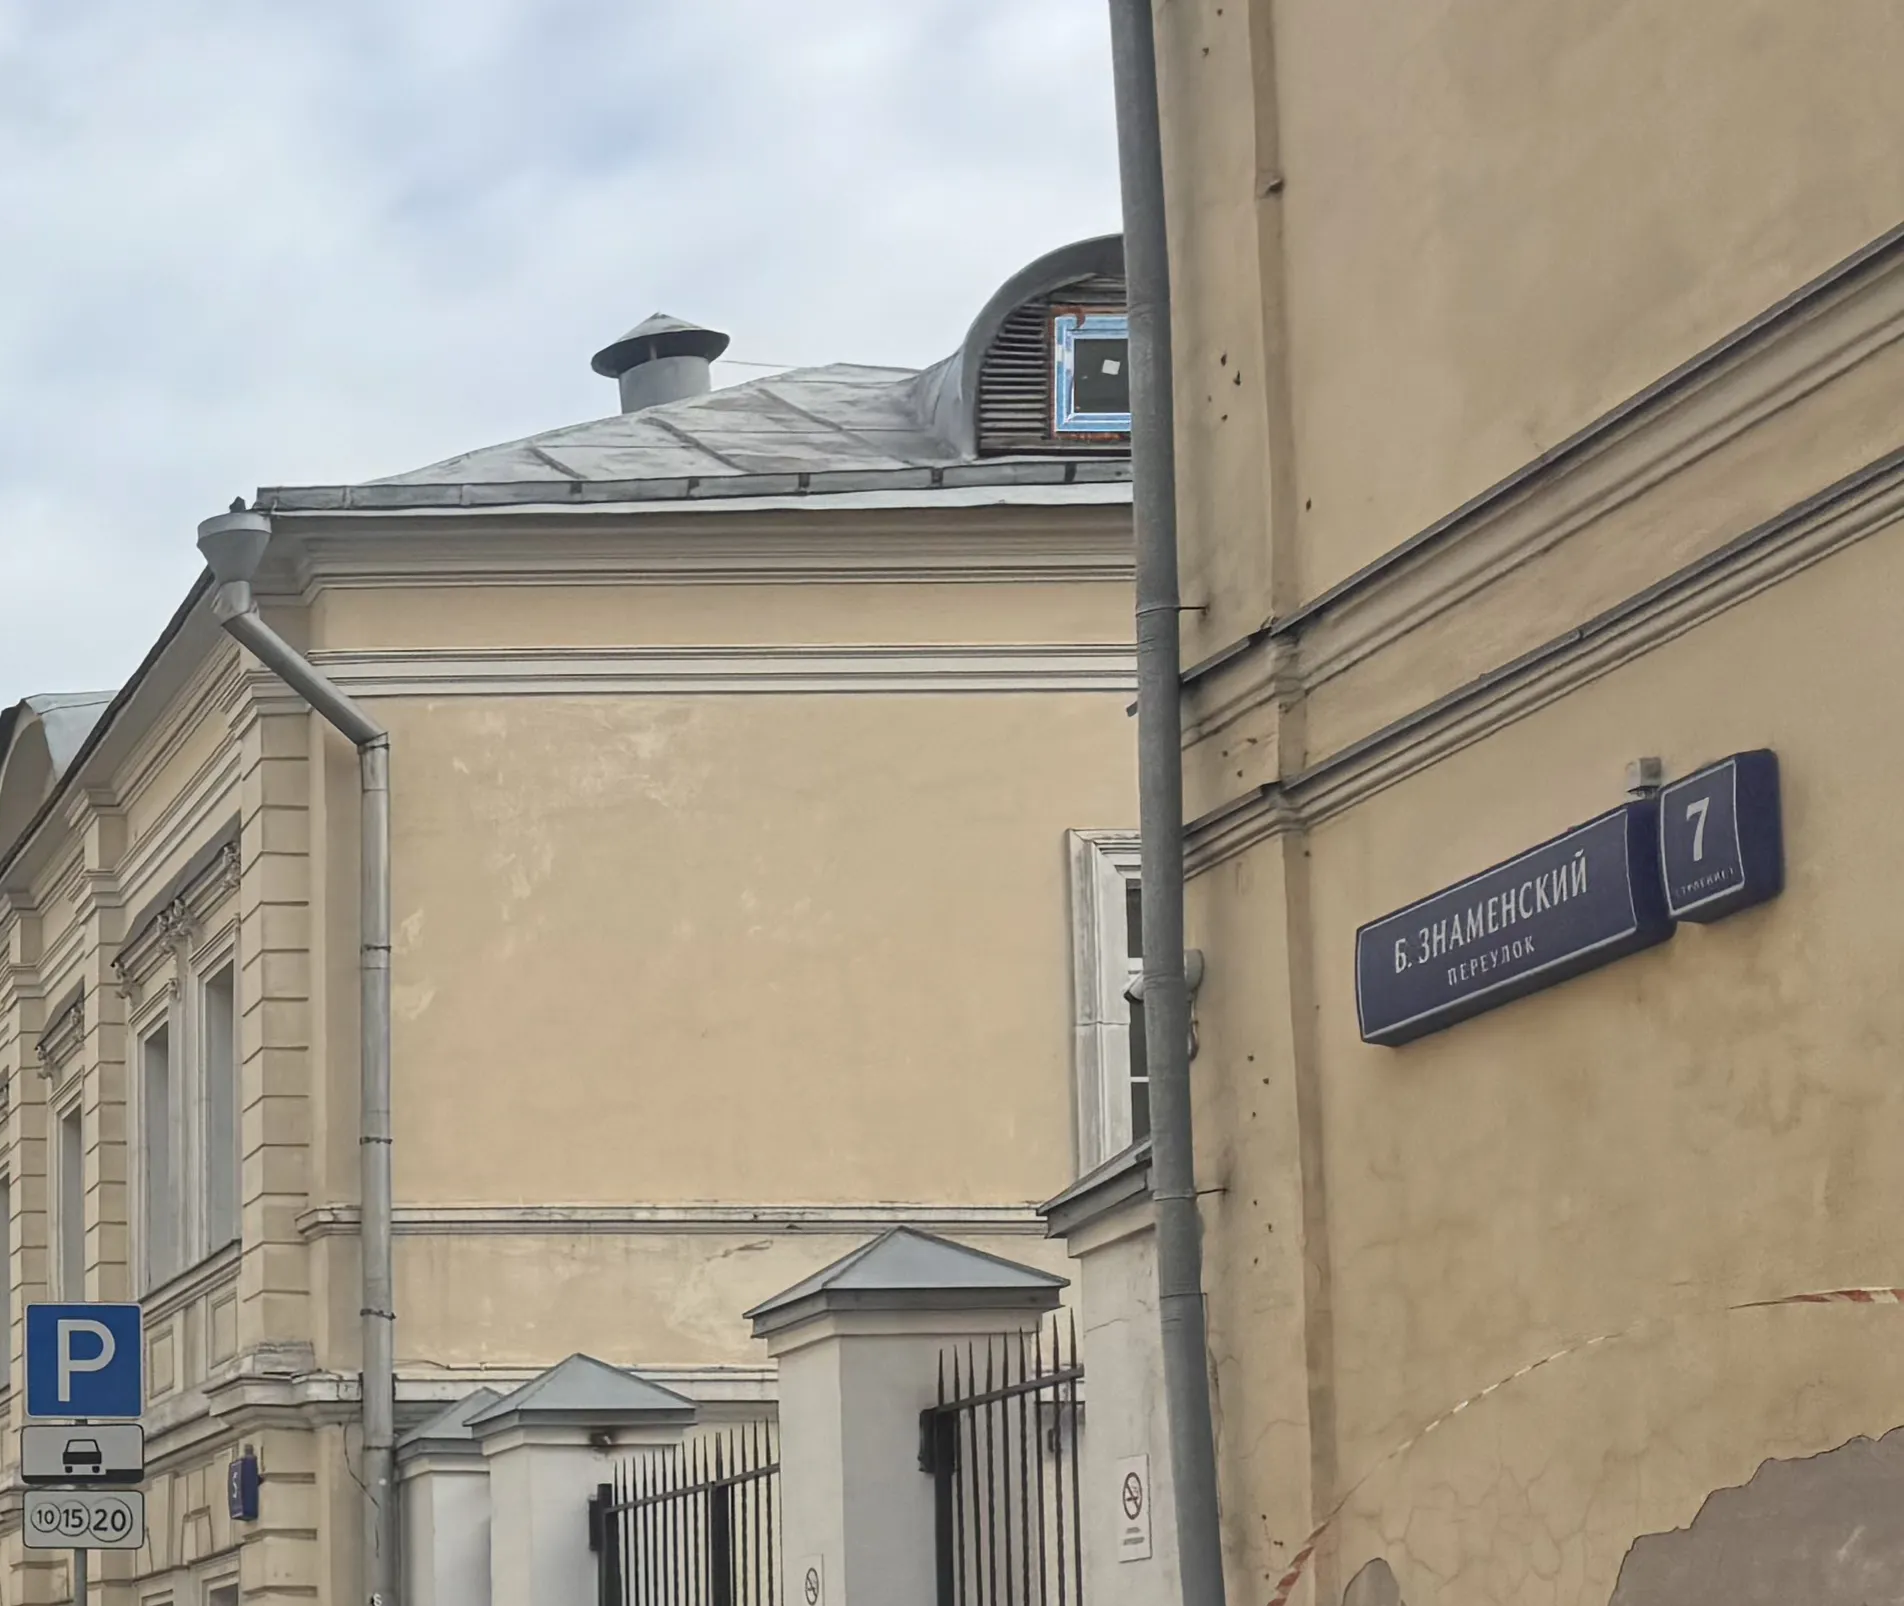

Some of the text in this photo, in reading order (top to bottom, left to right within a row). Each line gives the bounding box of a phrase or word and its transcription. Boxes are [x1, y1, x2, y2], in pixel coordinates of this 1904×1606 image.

[1686, 797, 1710, 862] 7
[1395, 849, 1589, 974] Б. ЗНАМЕНСКИЙ
[1447, 935, 1536, 987] ПЕРЕУЛОК
[57, 1319, 116, 1402] P
[36, 1508, 127, 1532] 10 15 20
